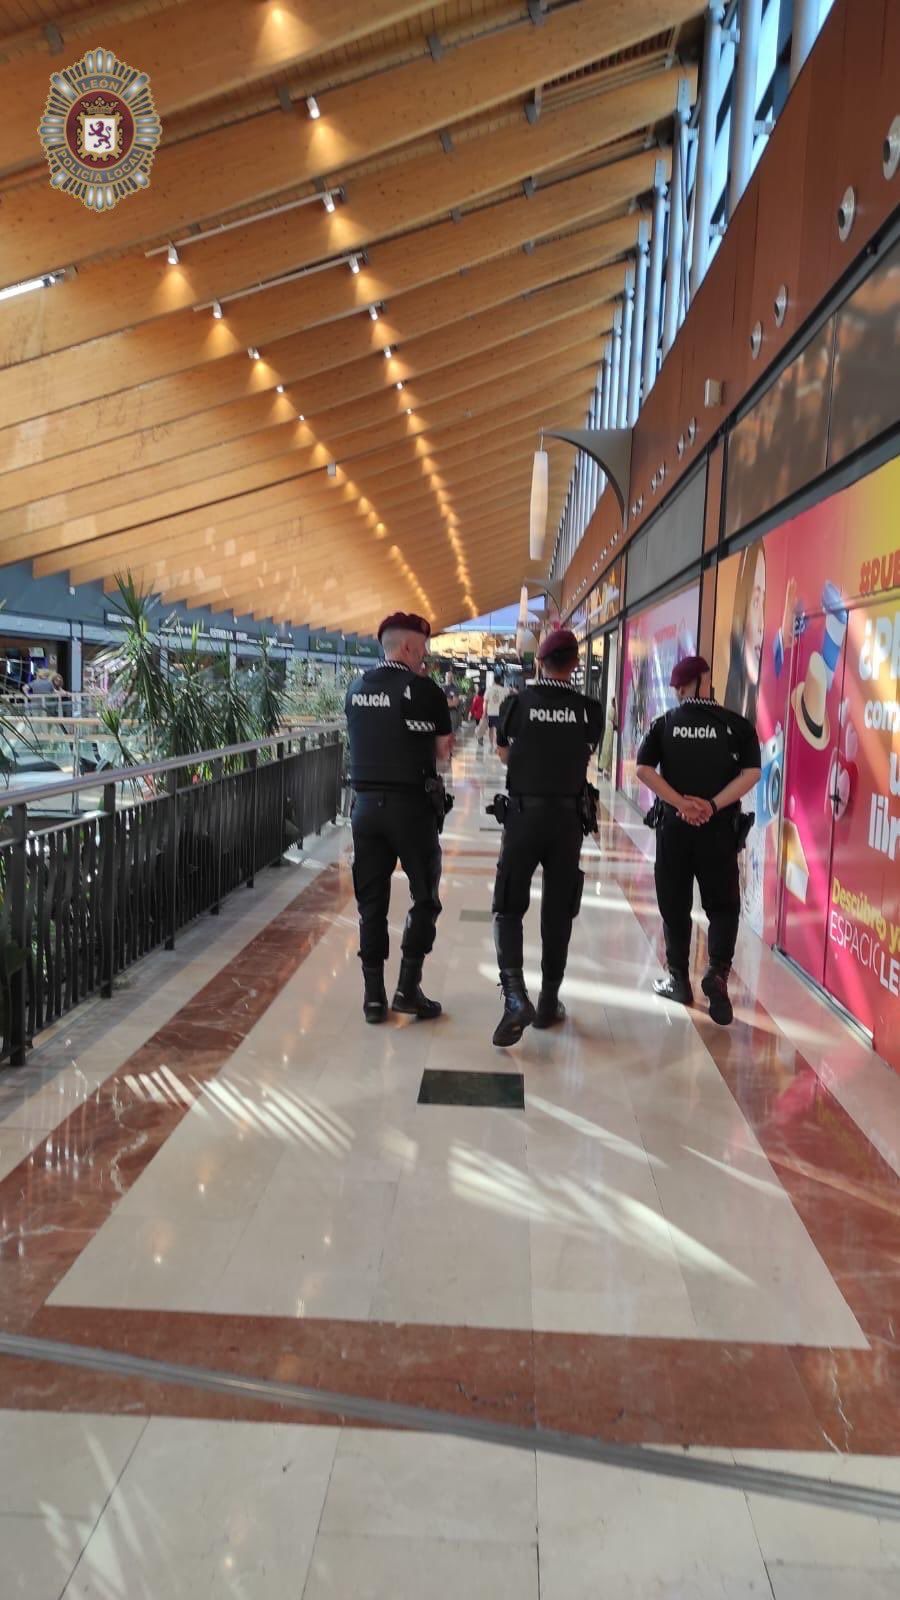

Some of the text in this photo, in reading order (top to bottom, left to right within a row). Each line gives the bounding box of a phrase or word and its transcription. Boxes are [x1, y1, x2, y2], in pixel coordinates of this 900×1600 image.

[351, 691, 391, 707] POLICÍA
[529, 706, 577, 724] POLICÍA
[672, 724, 717, 739] POLICÍA
